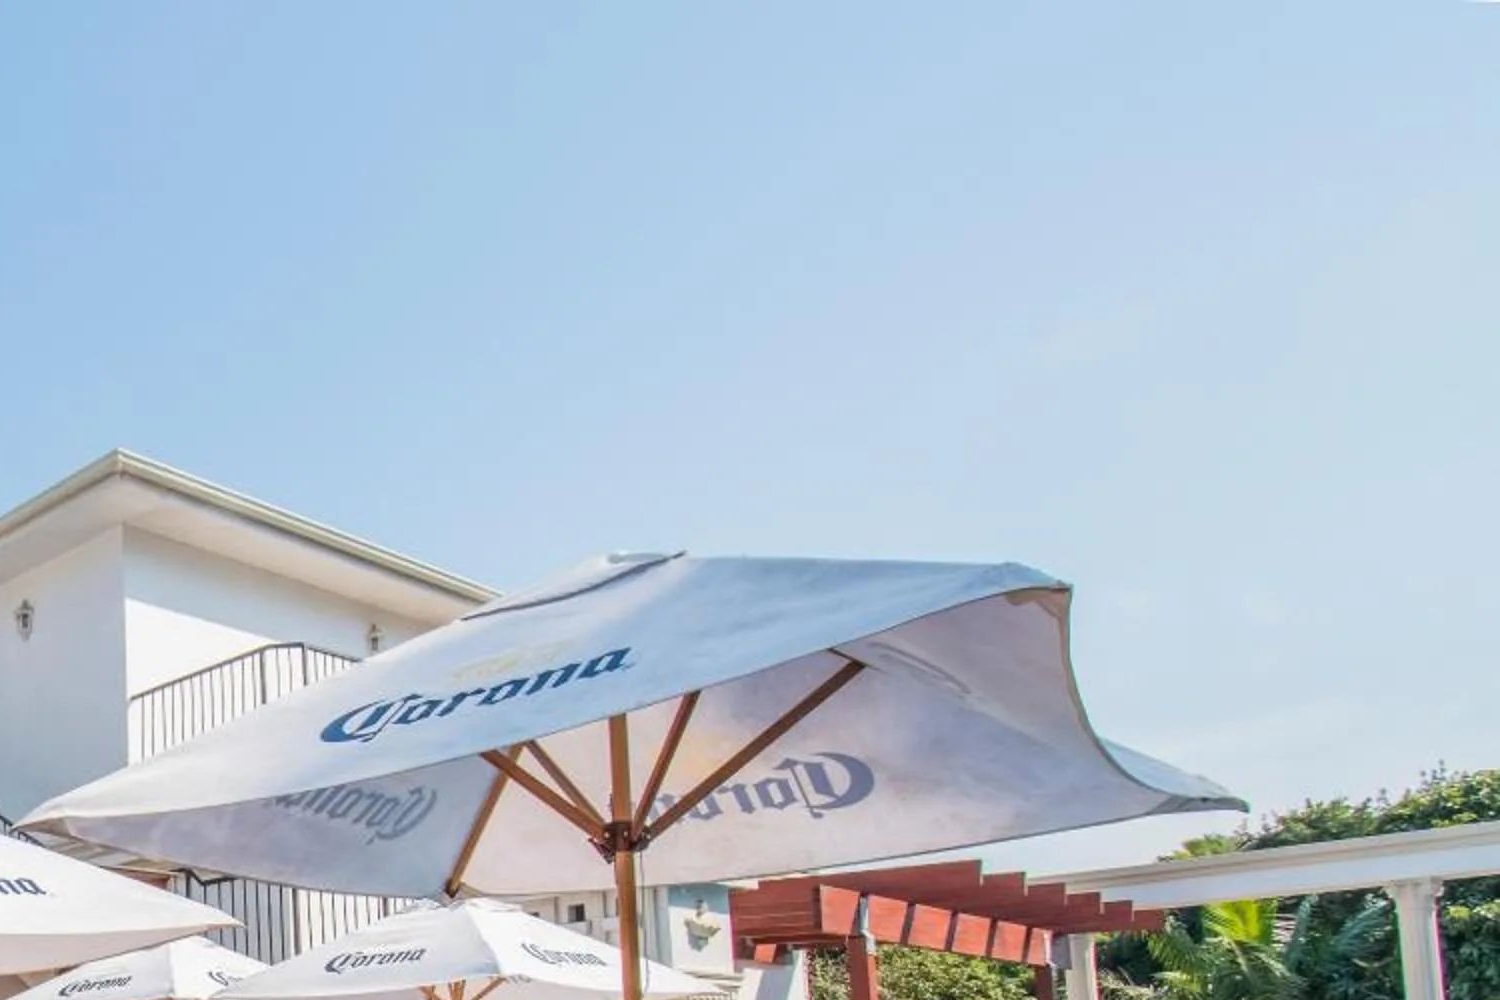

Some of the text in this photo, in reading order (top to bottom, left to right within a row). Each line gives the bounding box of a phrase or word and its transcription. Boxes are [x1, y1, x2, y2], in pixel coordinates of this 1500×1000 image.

[320, 647, 633, 742] Corona
[324, 947, 427, 975] Corona
[59, 975, 132, 997] Corona
